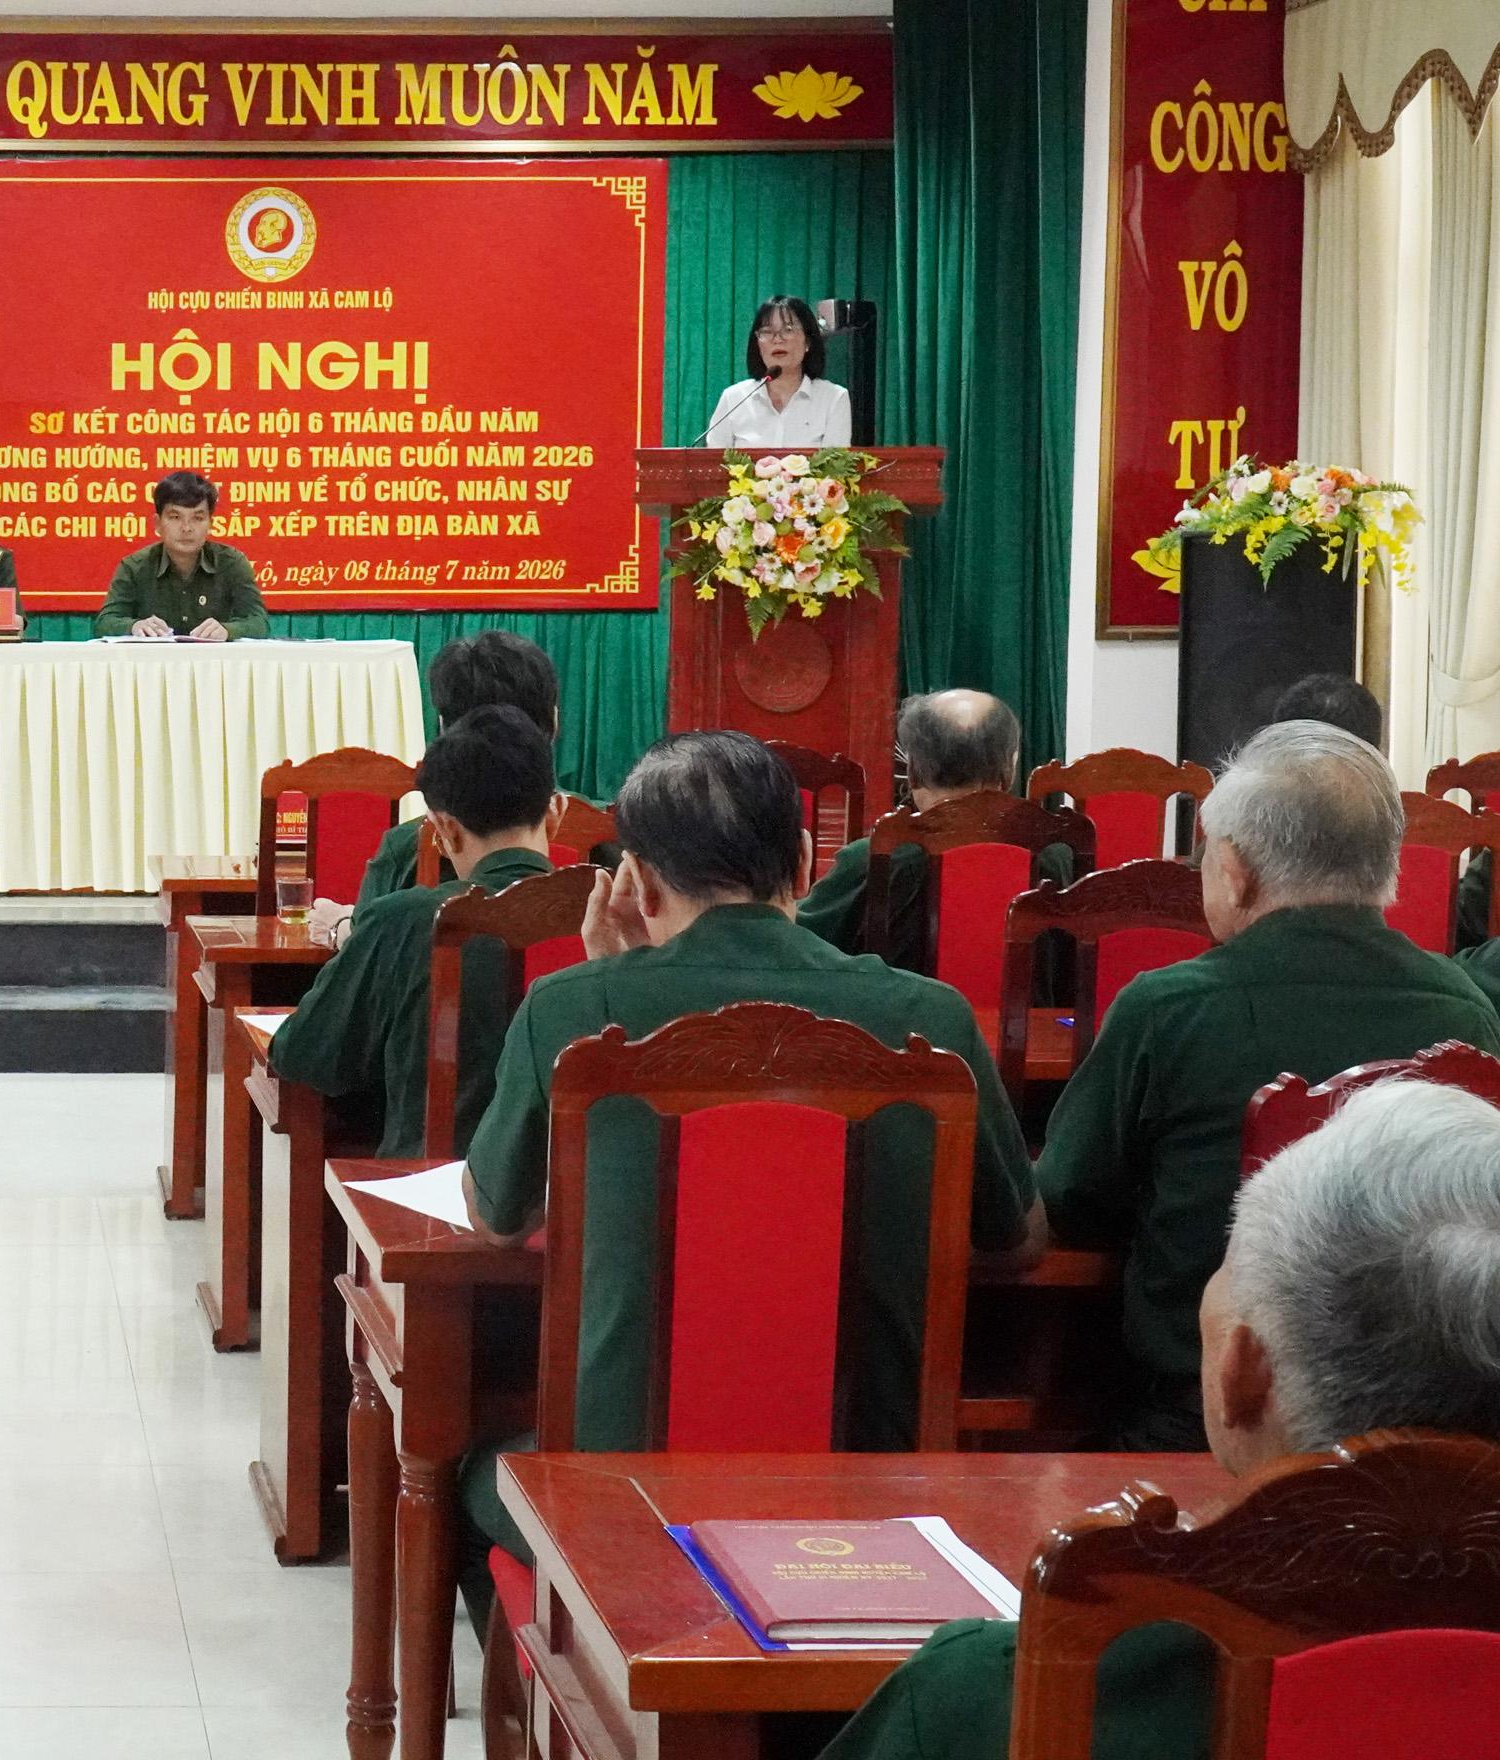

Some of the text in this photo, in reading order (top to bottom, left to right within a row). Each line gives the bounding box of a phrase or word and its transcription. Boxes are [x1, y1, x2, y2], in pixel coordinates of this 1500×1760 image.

[6, 60, 208, 138] QUANG
[223, 62, 380, 126] VINH
[395, 45, 569, 126] MUÔN
[583, 46, 718, 126] NĂM
[1150, 79, 1289, 173] CÔNG
[148, 286, 393, 313] HỘI CỰU CHIẾN BINH XÃ CAM LỘ
[1178, 240, 1248, 331] VÔ
[112, 328, 428, 405] HỘI NGHỊ
[30, 406, 538, 437] SƠ KẾT CÔNG TÁC HỘI 6 THÁNG ĐẦU NĂM
[55, 443, 148, 471] HƯỚNG,
[156, 443, 238, 472] NHIỆM
[247, 447, 278, 472] VỤ
[286, 447, 301, 468] 6
[309, 442, 391, 468] THÁNG
[400, 438, 458, 467] CUỐI
[466, 441, 524, 467] NĂM
[532, 446, 593, 467] 2026
[45, 474, 79, 503] BỐ
[87, 478, 137, 503] CÁC
[229, 481, 290, 507] ĐỊNH
[298, 474, 328, 502] VỀ
[336, 472, 368, 502] TỔ
[374, 476, 449, 503] CHỨC,
[457, 476, 527, 501] NHÂN
[535, 477, 572, 505] SỰ
[55, 516, 96, 537] CHI
[105, 512, 146, 542] HỘI
[211, 508, 260, 537] SẮP
[269, 509, 317, 537] XẾP
[324, 511, 389, 537] TRÊN
[396, 515, 439, 540] ĐỊA
[447, 511, 498, 536] BÀN
[507, 511, 540, 535] XÃ
[285, 563, 339, 586] ngày
[344, 560, 370, 581] 08
[375, 559, 440, 585] tháng
[446, 560, 460, 580] 7
[464, 561, 510, 580] năm
[515, 559, 567, 580] 2026
